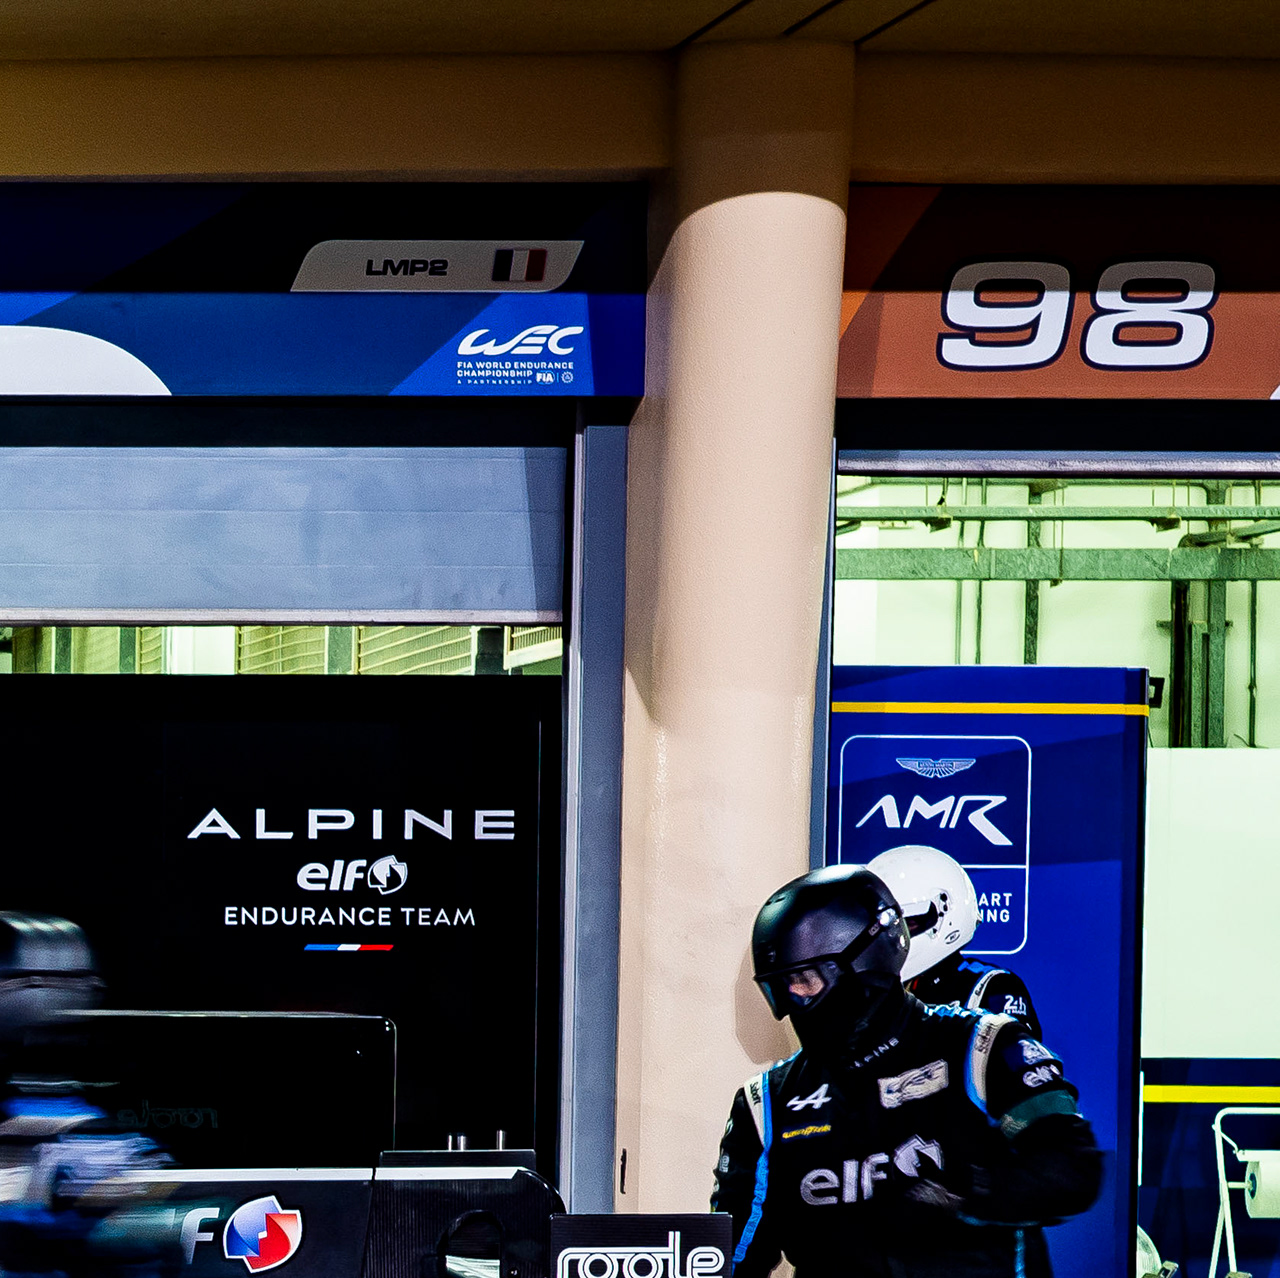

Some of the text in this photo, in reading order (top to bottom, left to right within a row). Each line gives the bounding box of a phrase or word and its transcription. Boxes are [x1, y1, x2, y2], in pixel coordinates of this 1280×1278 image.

[366, 258, 448, 277] LMP2
[939, 259, 1217, 368] 98
[457, 325, 584, 355] WEC
[457, 361, 574, 369] FIA WORLD ENDURANCE
[187, 807, 516, 841] ALPINE
[854, 794, 1014, 847] AMR
[296, 858, 368, 892] elf
[224, 907, 476, 927] ENDURANCE TEAM
[800, 1152, 890, 1206] elf
